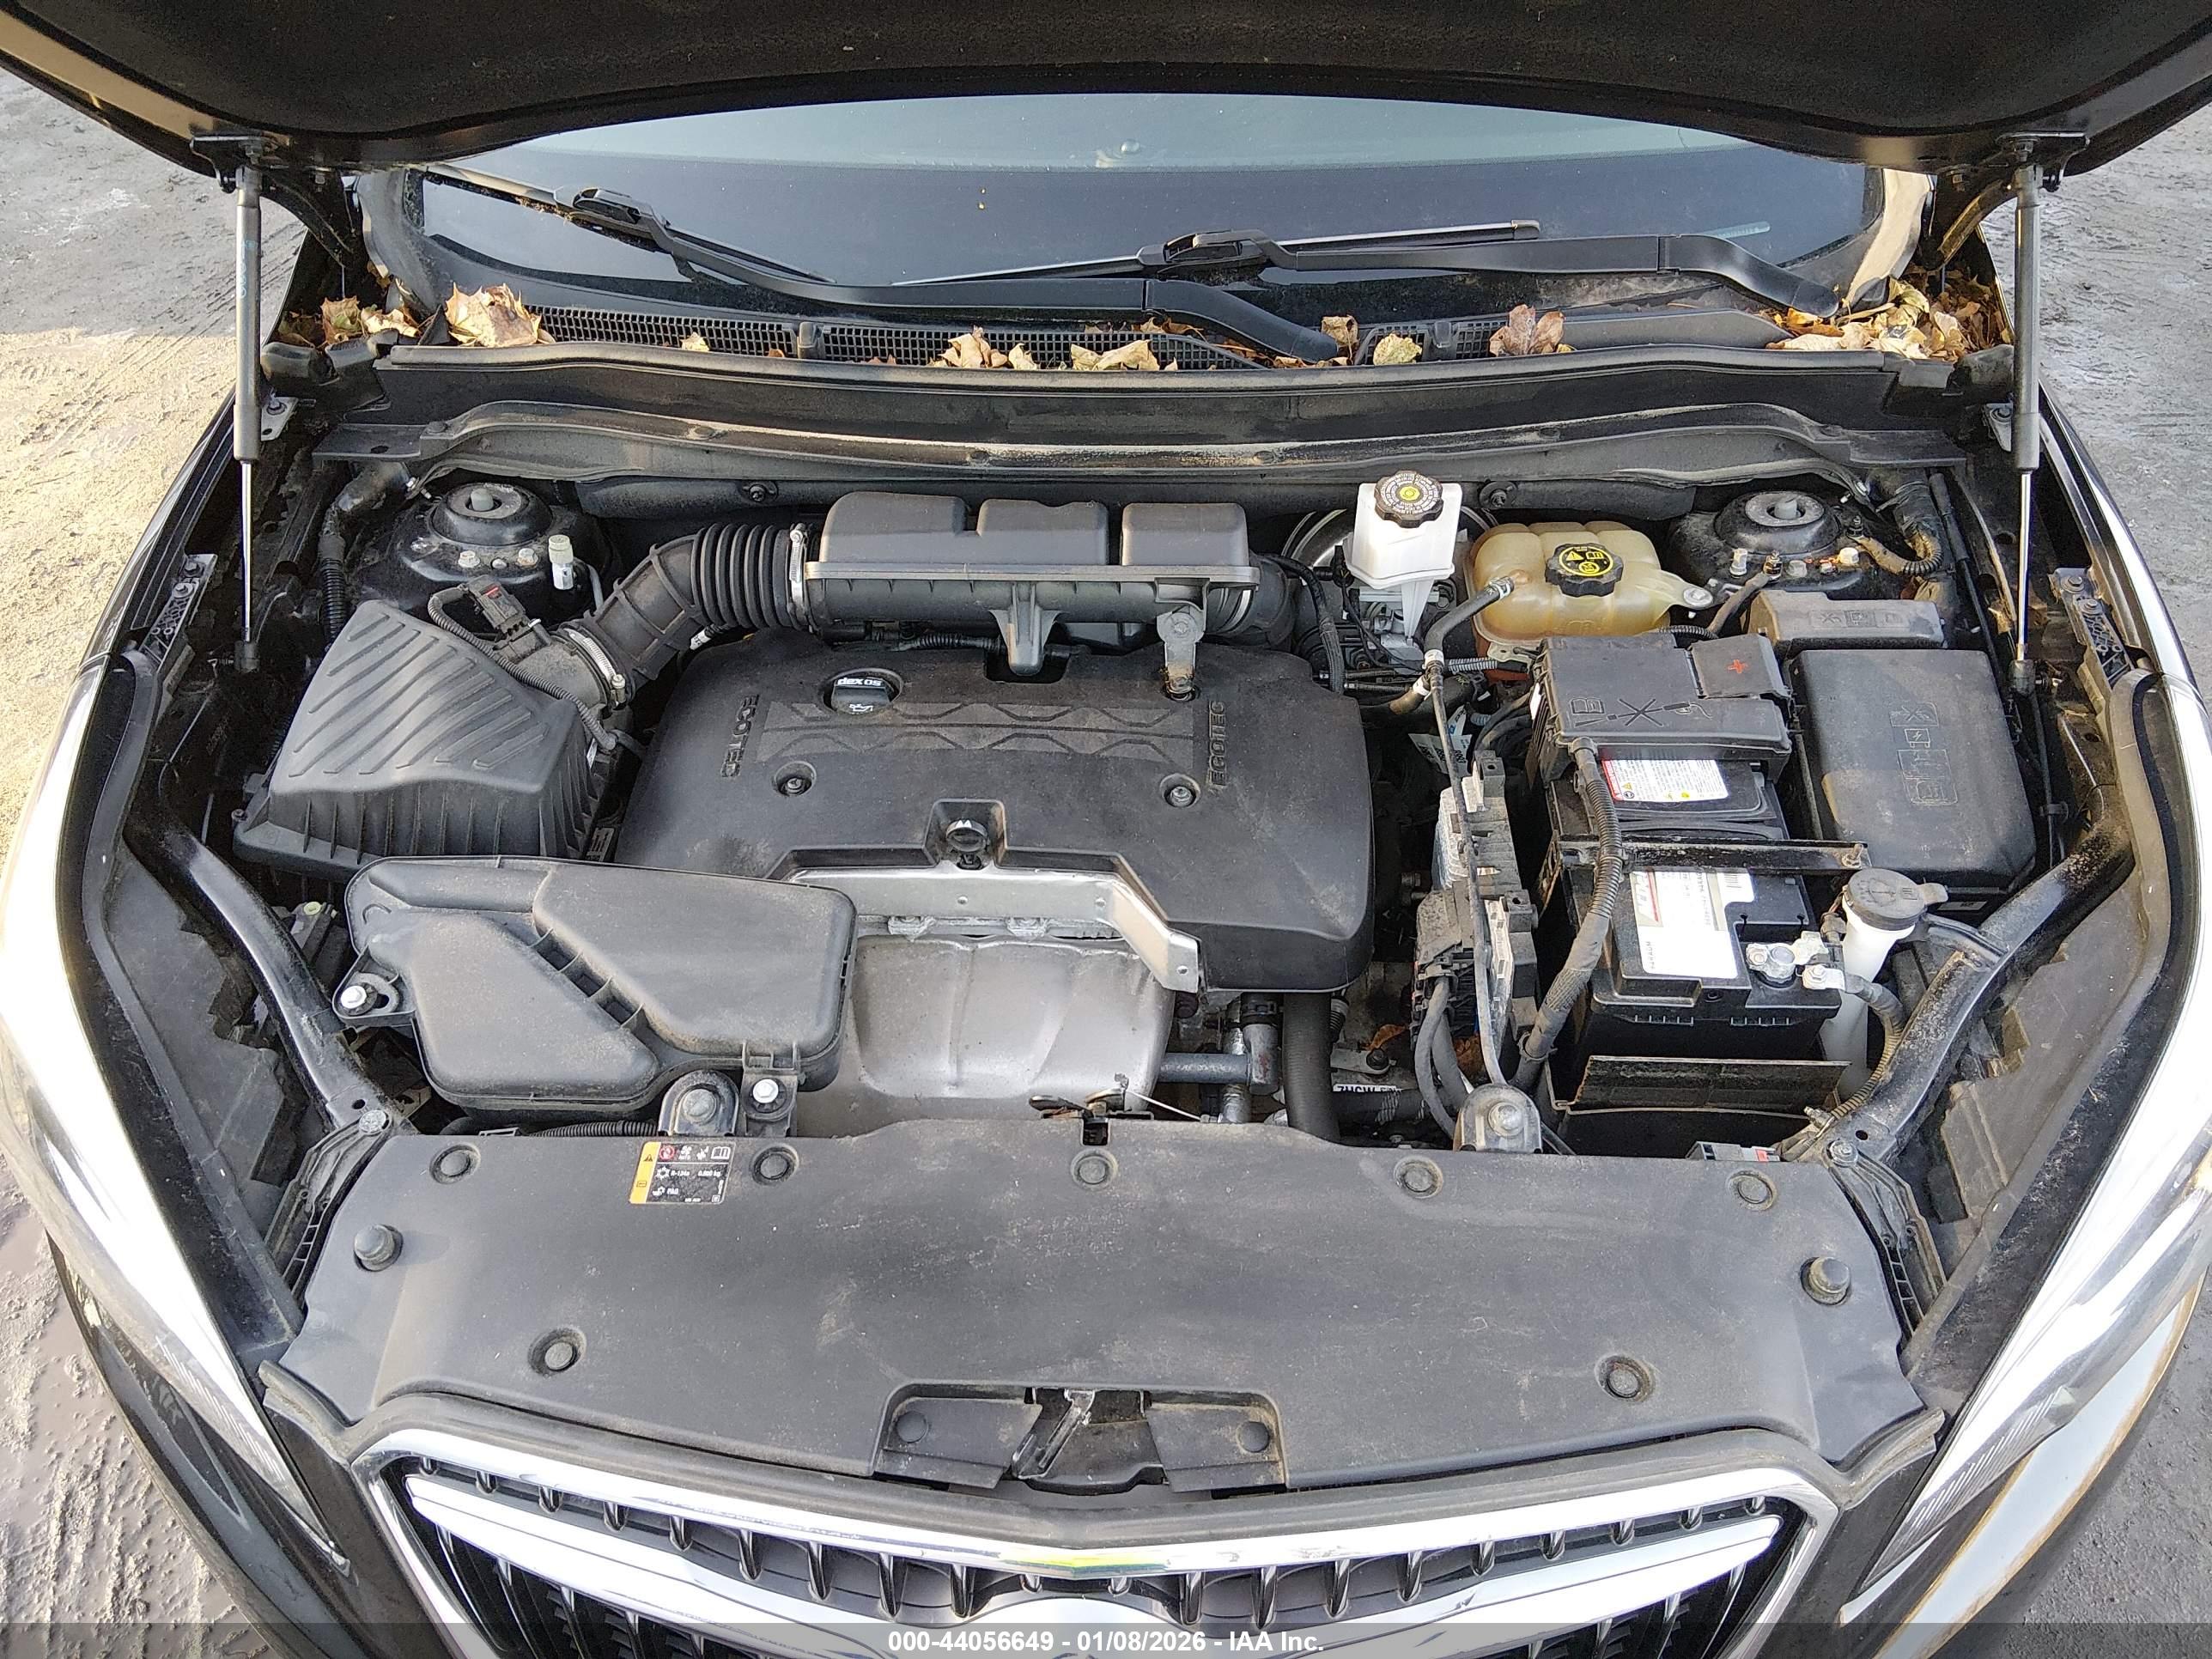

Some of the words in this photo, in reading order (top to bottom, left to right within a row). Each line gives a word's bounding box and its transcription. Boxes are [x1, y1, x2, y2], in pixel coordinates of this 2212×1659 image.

[837, 678, 882, 686] dexos
[720, 694, 759, 778] ECOTEC
[1209, 699, 1228, 787] ECOTEC
